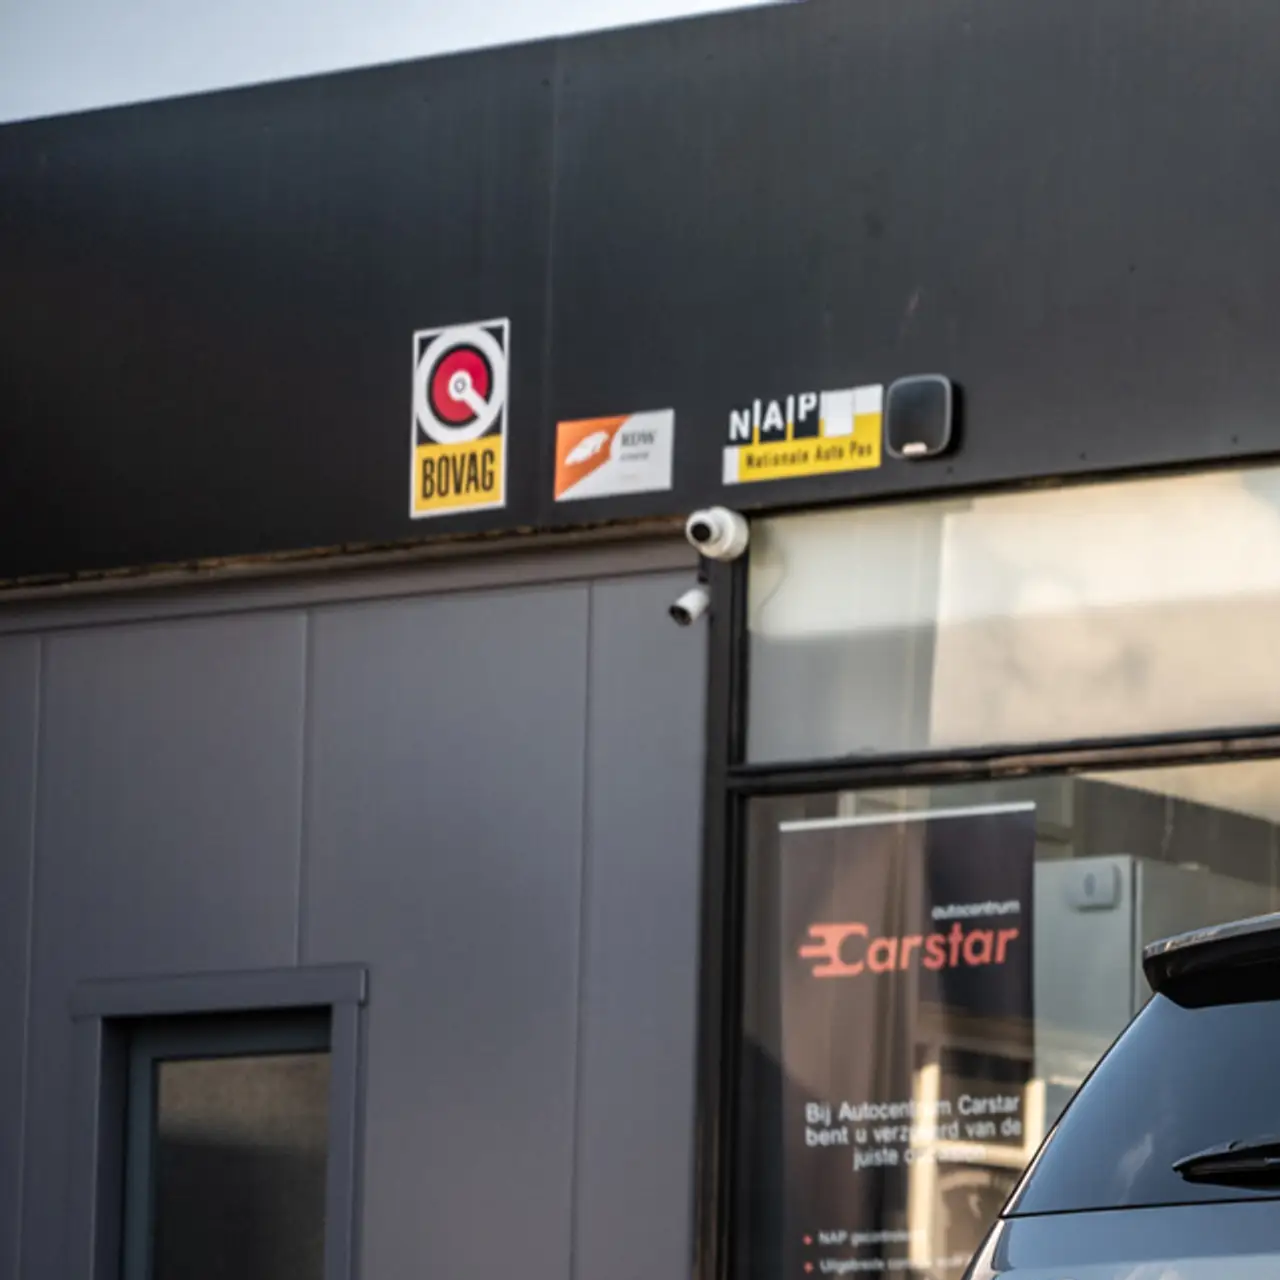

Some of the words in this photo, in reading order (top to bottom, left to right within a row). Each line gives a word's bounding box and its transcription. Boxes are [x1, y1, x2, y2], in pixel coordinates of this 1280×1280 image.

[745, 449, 809, 468] Nationale
[815, 444, 844, 461] Auto
[421, 448, 496, 500] BOVAG
[931, 900, 1021, 920] autocentrum
[798, 921, 1019, 977] Carstar
[805, 1103, 832, 1126] Bij
[957, 1094, 1019, 1116] Carstar
[805, 1126, 850, 1147] bent
[855, 1131, 868, 1144] u
[965, 1119, 996, 1138] van
[1000, 1116, 1022, 1136] de
[852, 1147, 899, 1171] juiste
